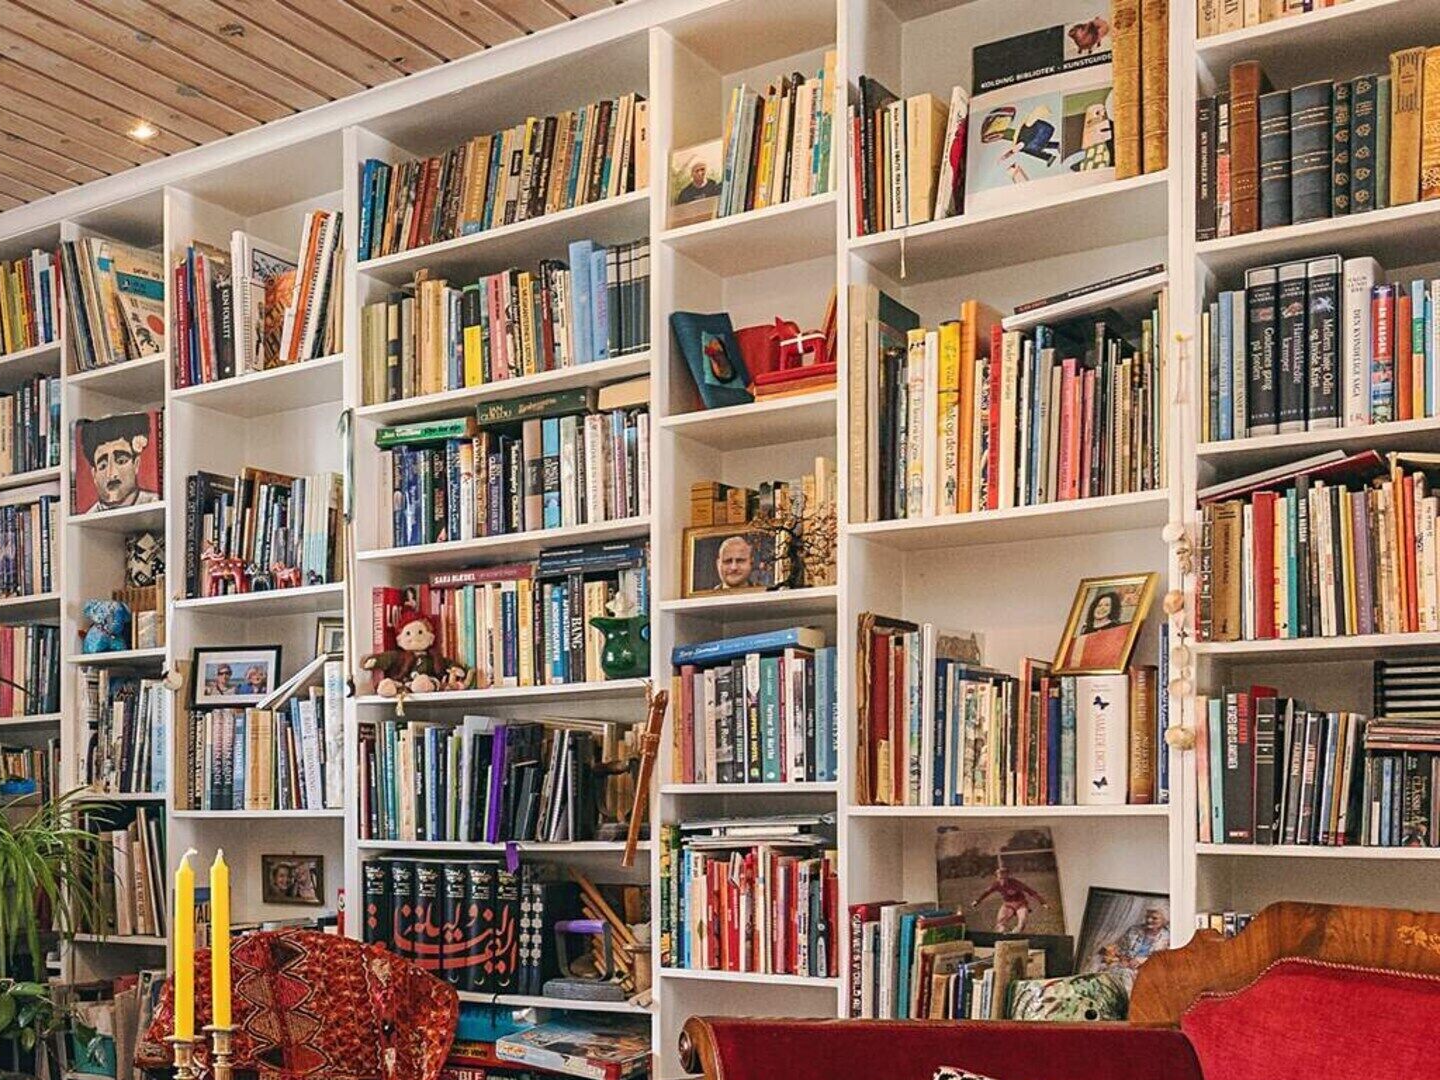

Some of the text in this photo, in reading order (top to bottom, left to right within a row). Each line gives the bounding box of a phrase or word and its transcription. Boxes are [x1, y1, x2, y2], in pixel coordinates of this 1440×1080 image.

[222, 289, 231, 338] KEN FOLLETT
[1353, 309, 1361, 328] DEN
[1323, 319, 1333, 350] Mellem
[1262, 328, 1275, 390] Gudernes gang
[1310, 329, 1321, 387] og hvide Krist
[1323, 373, 1335, 394] Odin
[1352, 378, 1361, 397] SAGA
[434, 573, 452, 584] SARA
[572, 616, 583, 650] BANG
[852, 963, 862, 994] WORLD
